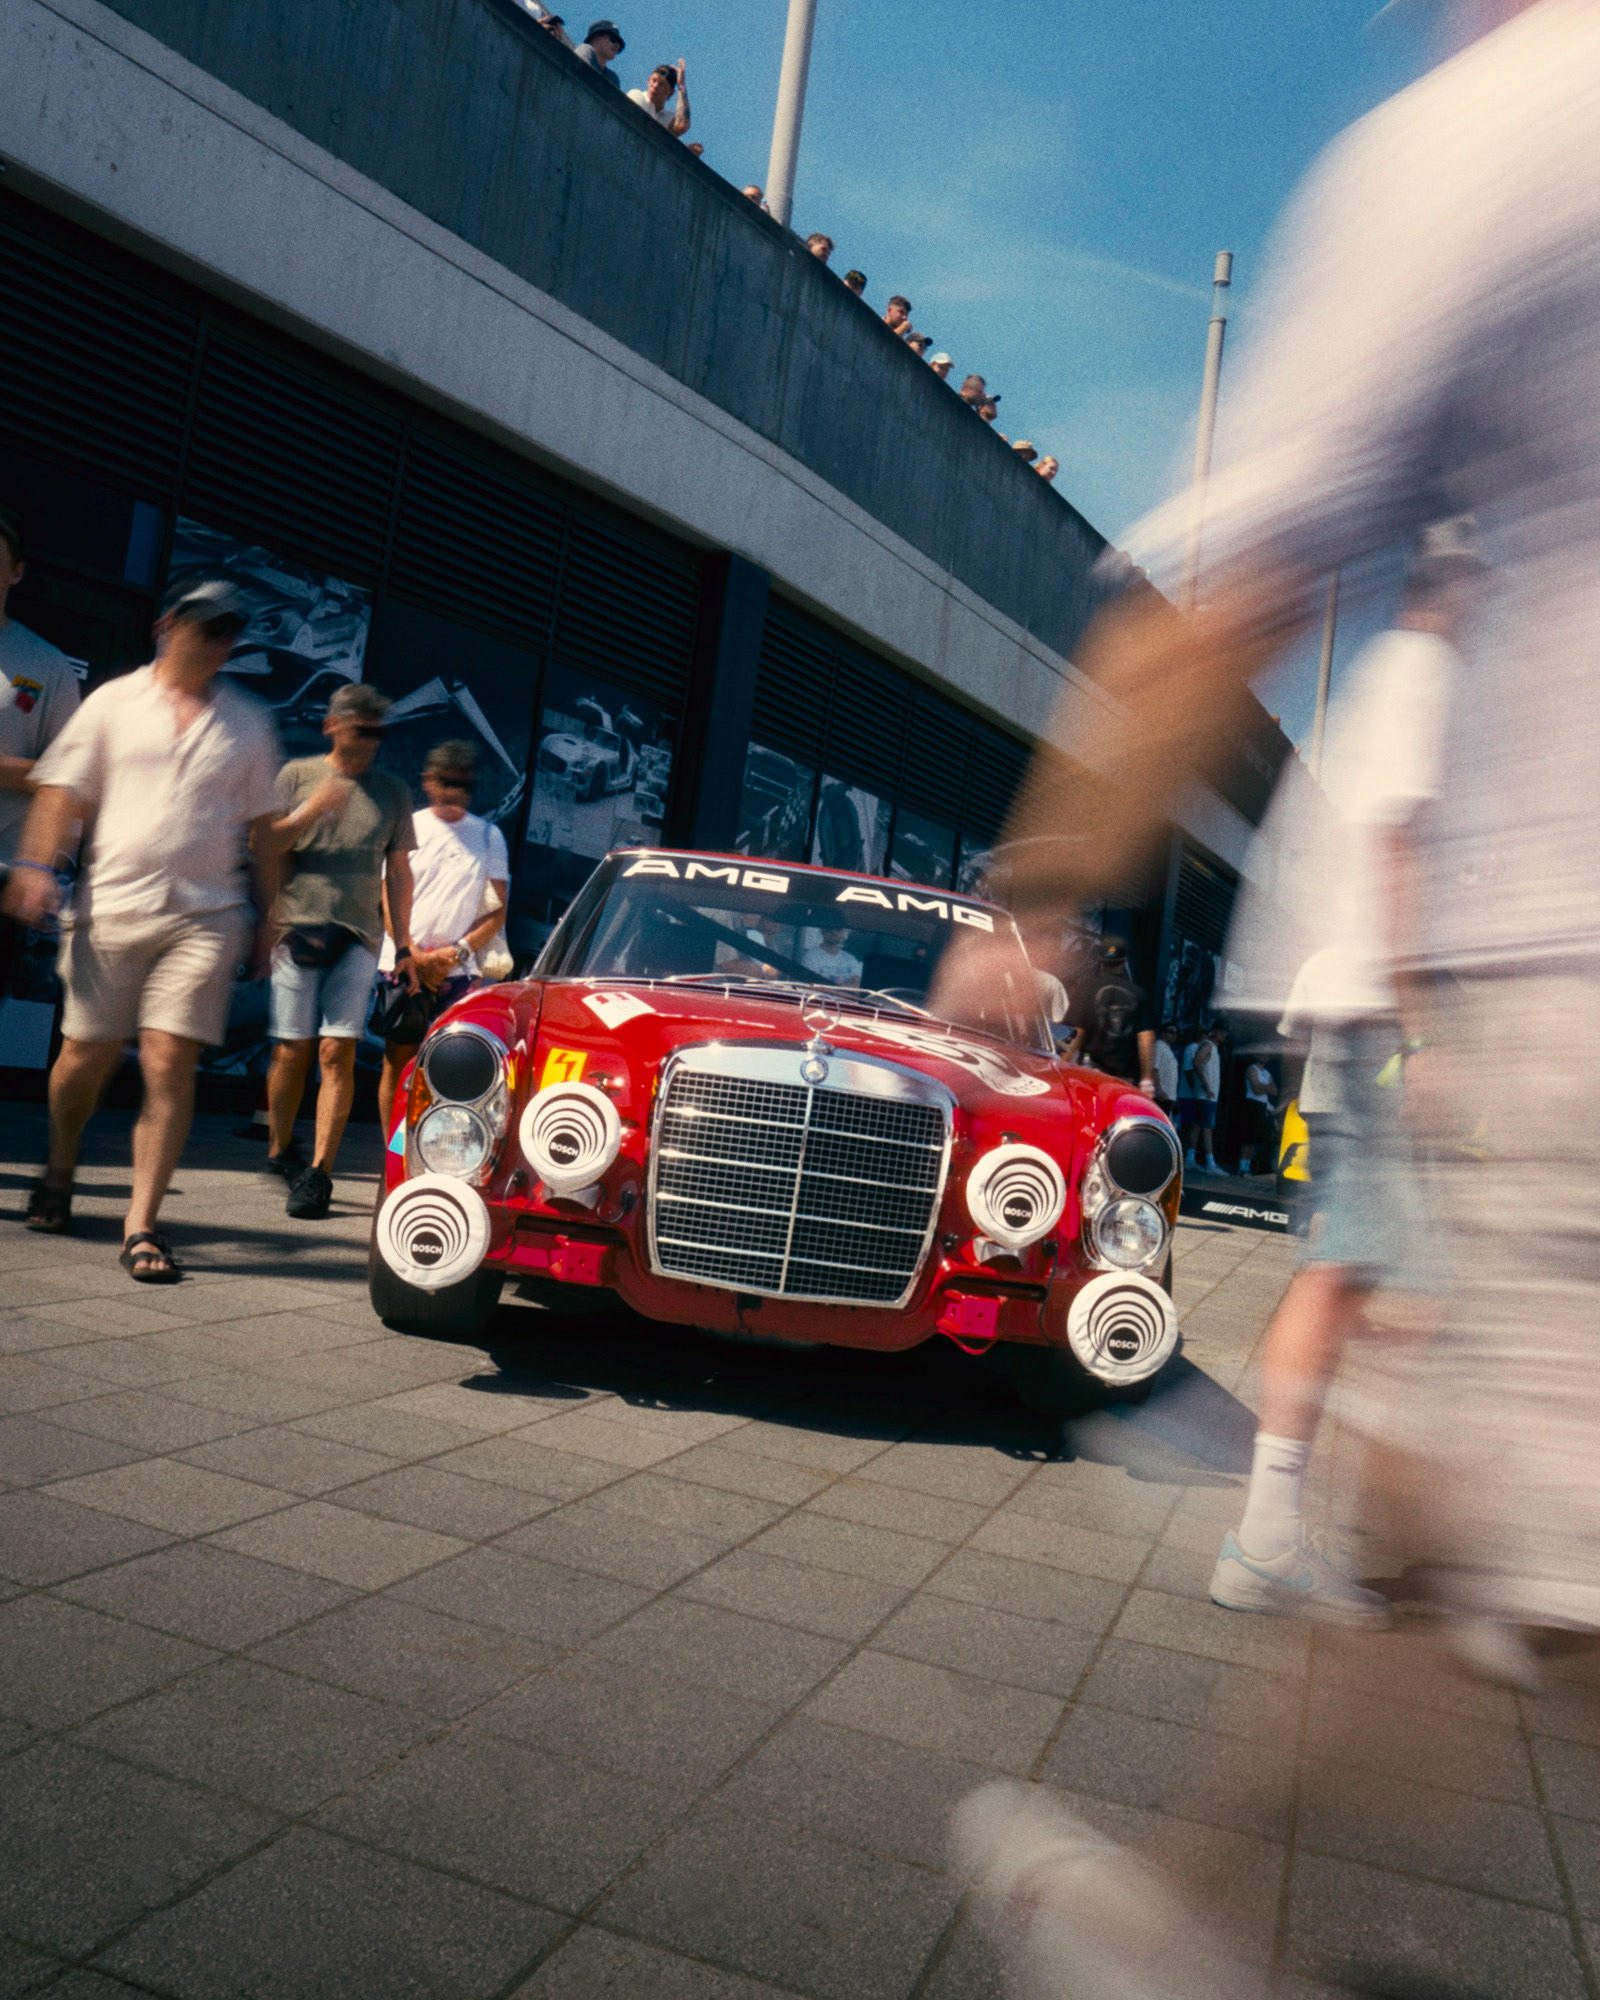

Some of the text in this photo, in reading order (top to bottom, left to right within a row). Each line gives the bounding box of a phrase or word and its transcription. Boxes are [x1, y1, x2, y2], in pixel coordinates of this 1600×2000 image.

[622, 859, 995, 933] AMG AMG
[551, 1141, 579, 1157] BOSCH
[1004, 1206, 1032, 1218] BOSCH
[1228, 1205, 1290, 1224] AMG
[411, 1243, 443, 1255] BOSCH
[1109, 1338, 1139, 1350] BOSCH
